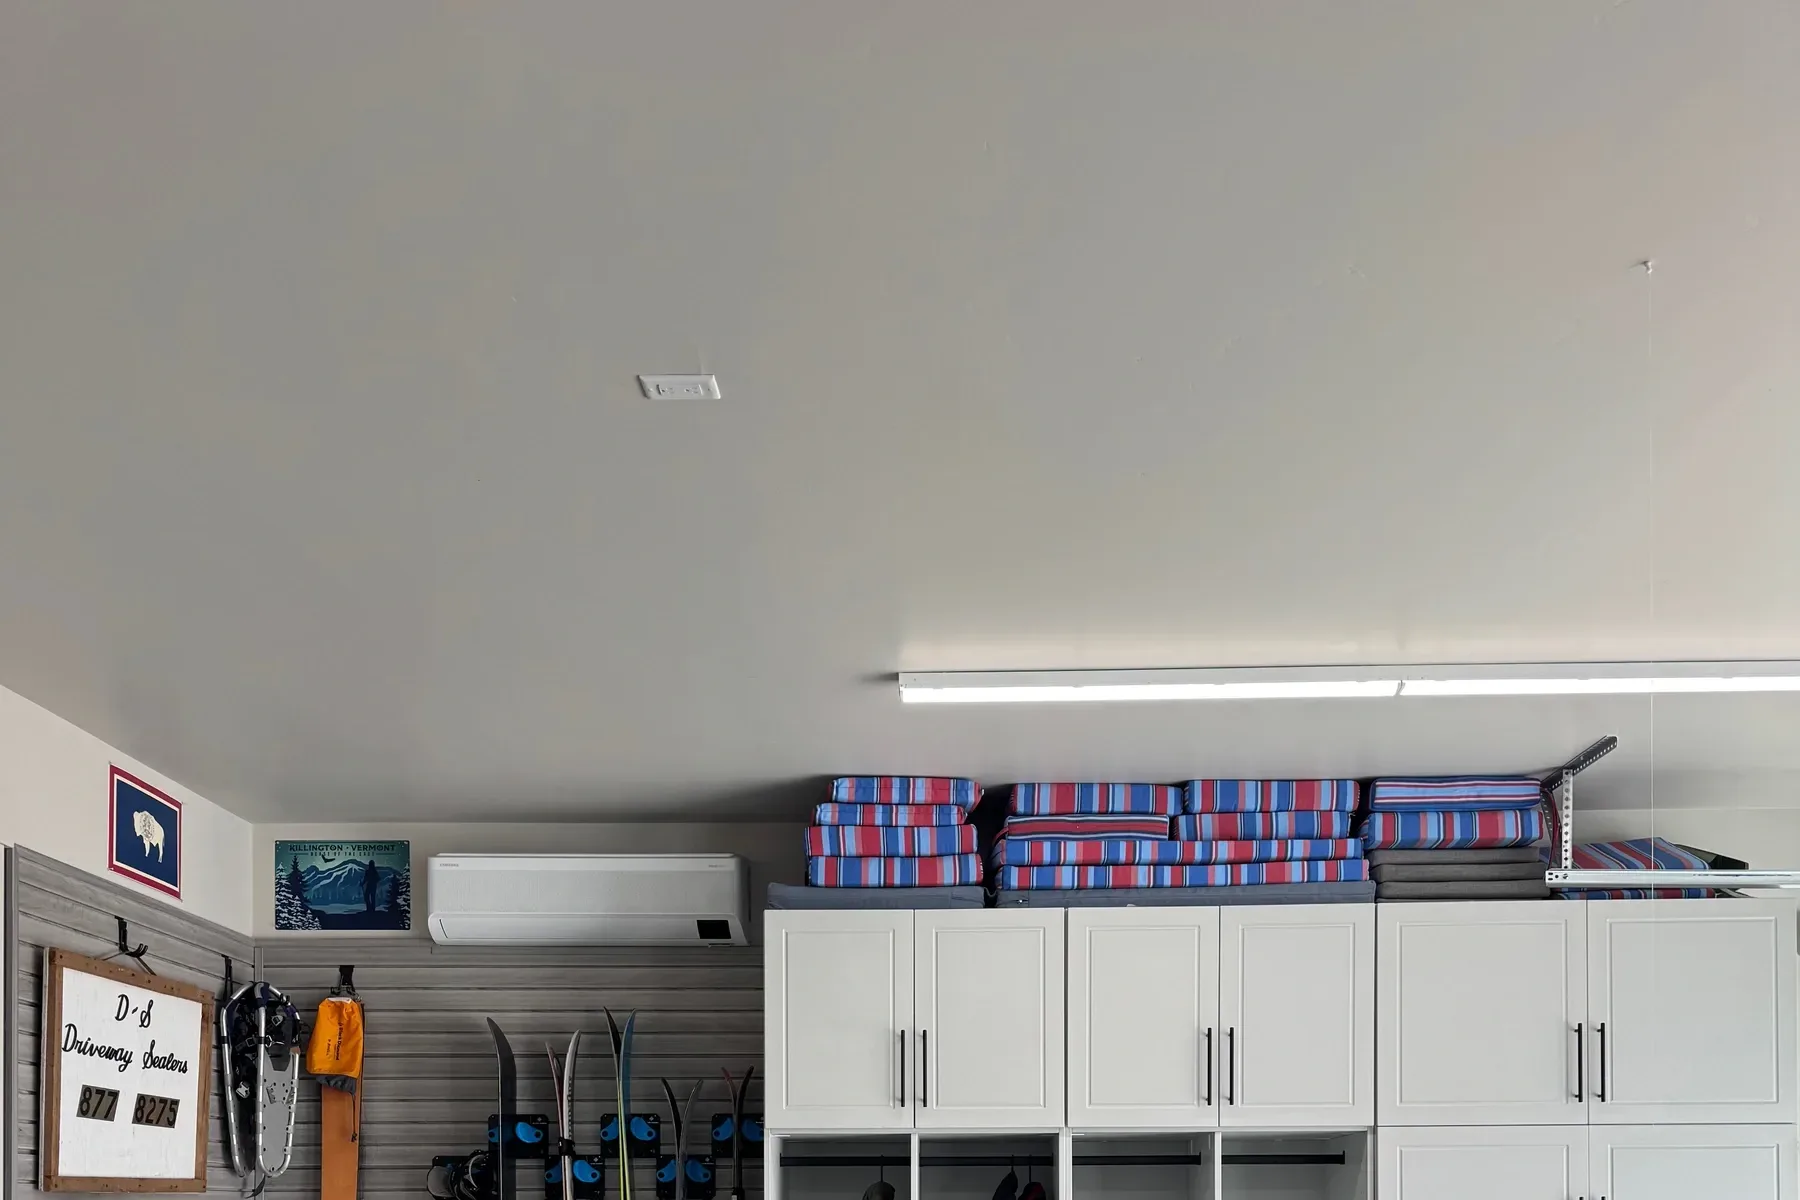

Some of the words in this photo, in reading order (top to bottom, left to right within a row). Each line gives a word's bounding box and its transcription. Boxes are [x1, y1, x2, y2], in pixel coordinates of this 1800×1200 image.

[289, 844, 343, 852] KILLINGTON
[350, 844, 396, 852] VERMONT
[62, 1023, 133, 1073] Driveway
[142, 1039, 188, 1074] Sealers
[80, 1086, 119, 1120] 877
[135, 1095, 179, 1127] 8275
